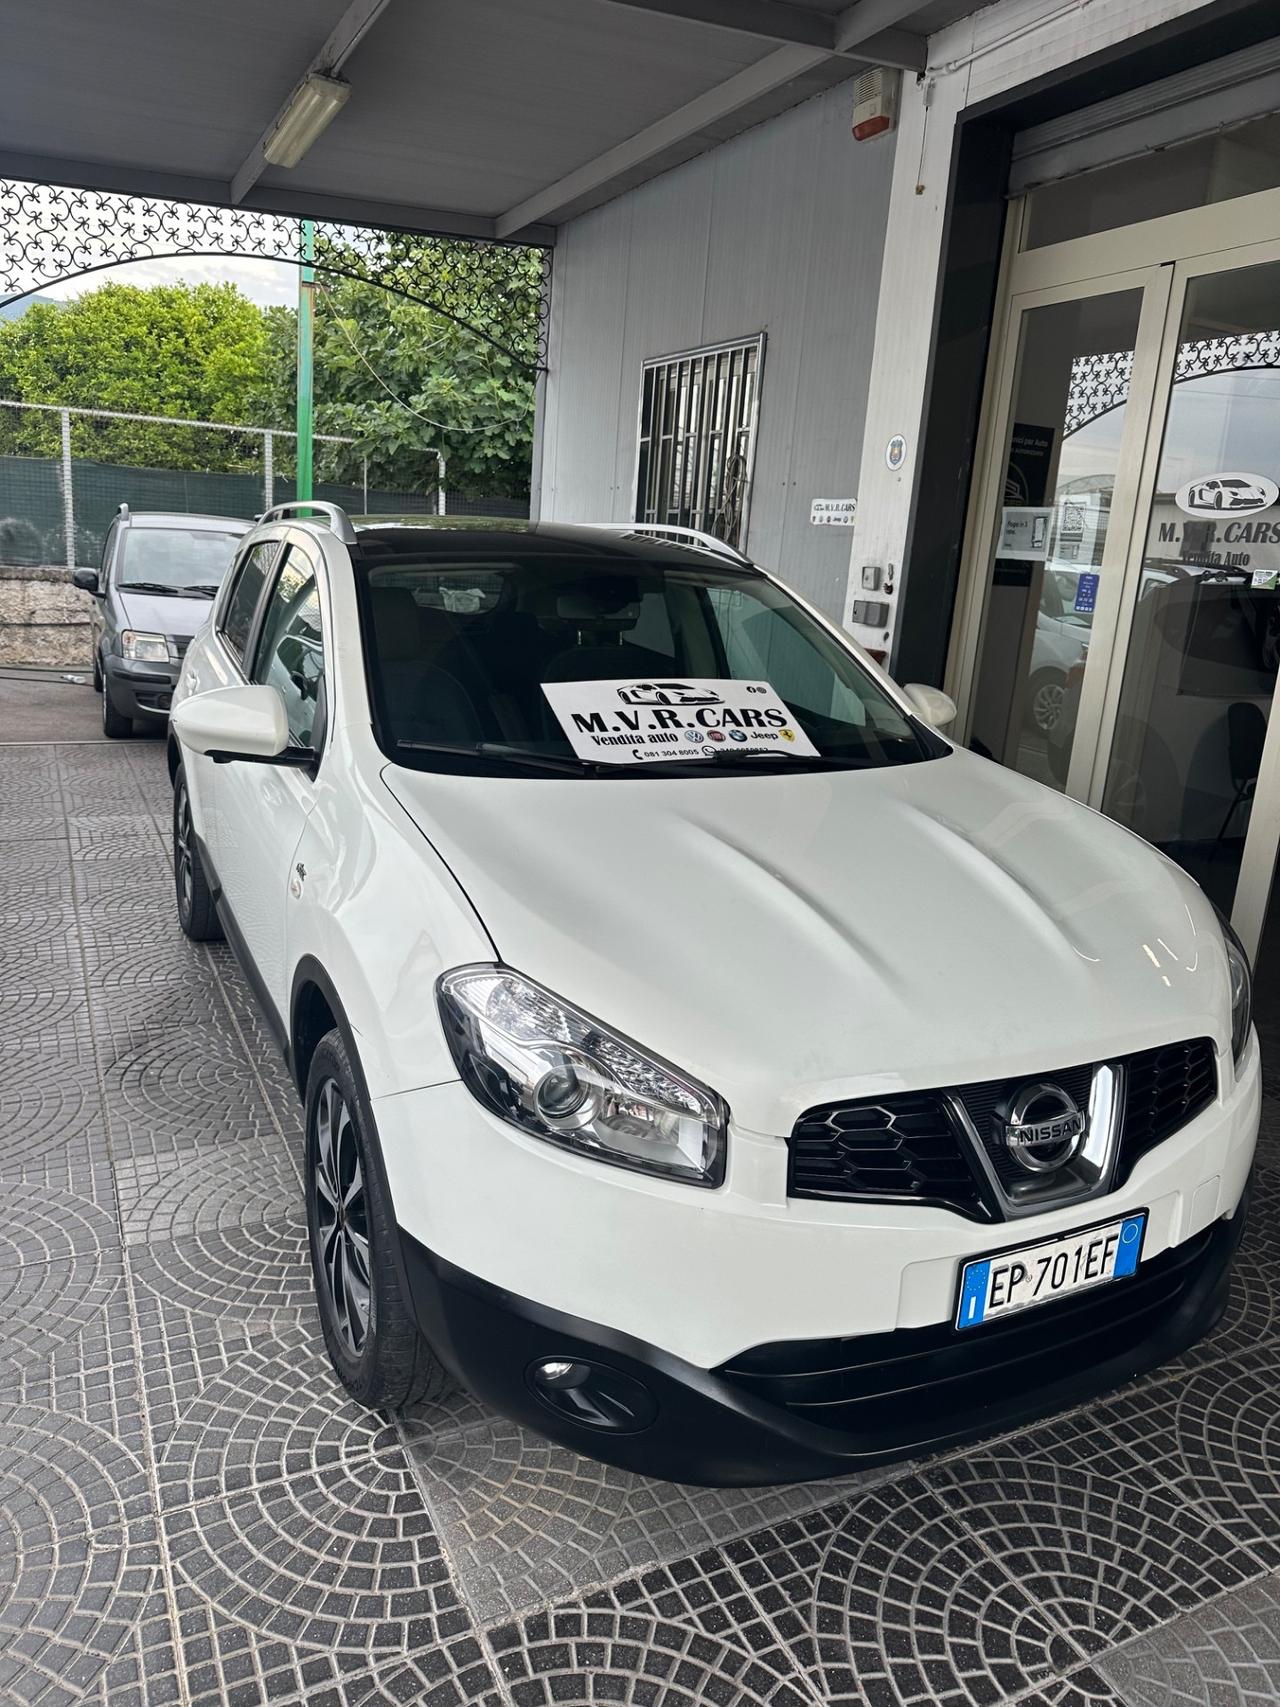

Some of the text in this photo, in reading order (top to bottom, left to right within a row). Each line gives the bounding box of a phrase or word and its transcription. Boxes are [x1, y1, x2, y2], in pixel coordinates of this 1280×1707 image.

[1223, 551, 1251, 566] Auto
[571, 708, 787, 733] M.V.R.CARS
[591, 732, 679, 746] Vendita auto
[751, 731, 779, 740] Jeep
[1019, 1119, 1083, 1143] NISSAN
[988, 1234, 1119, 1309] EP 701EF
[968, 1296, 977, 1319] I
